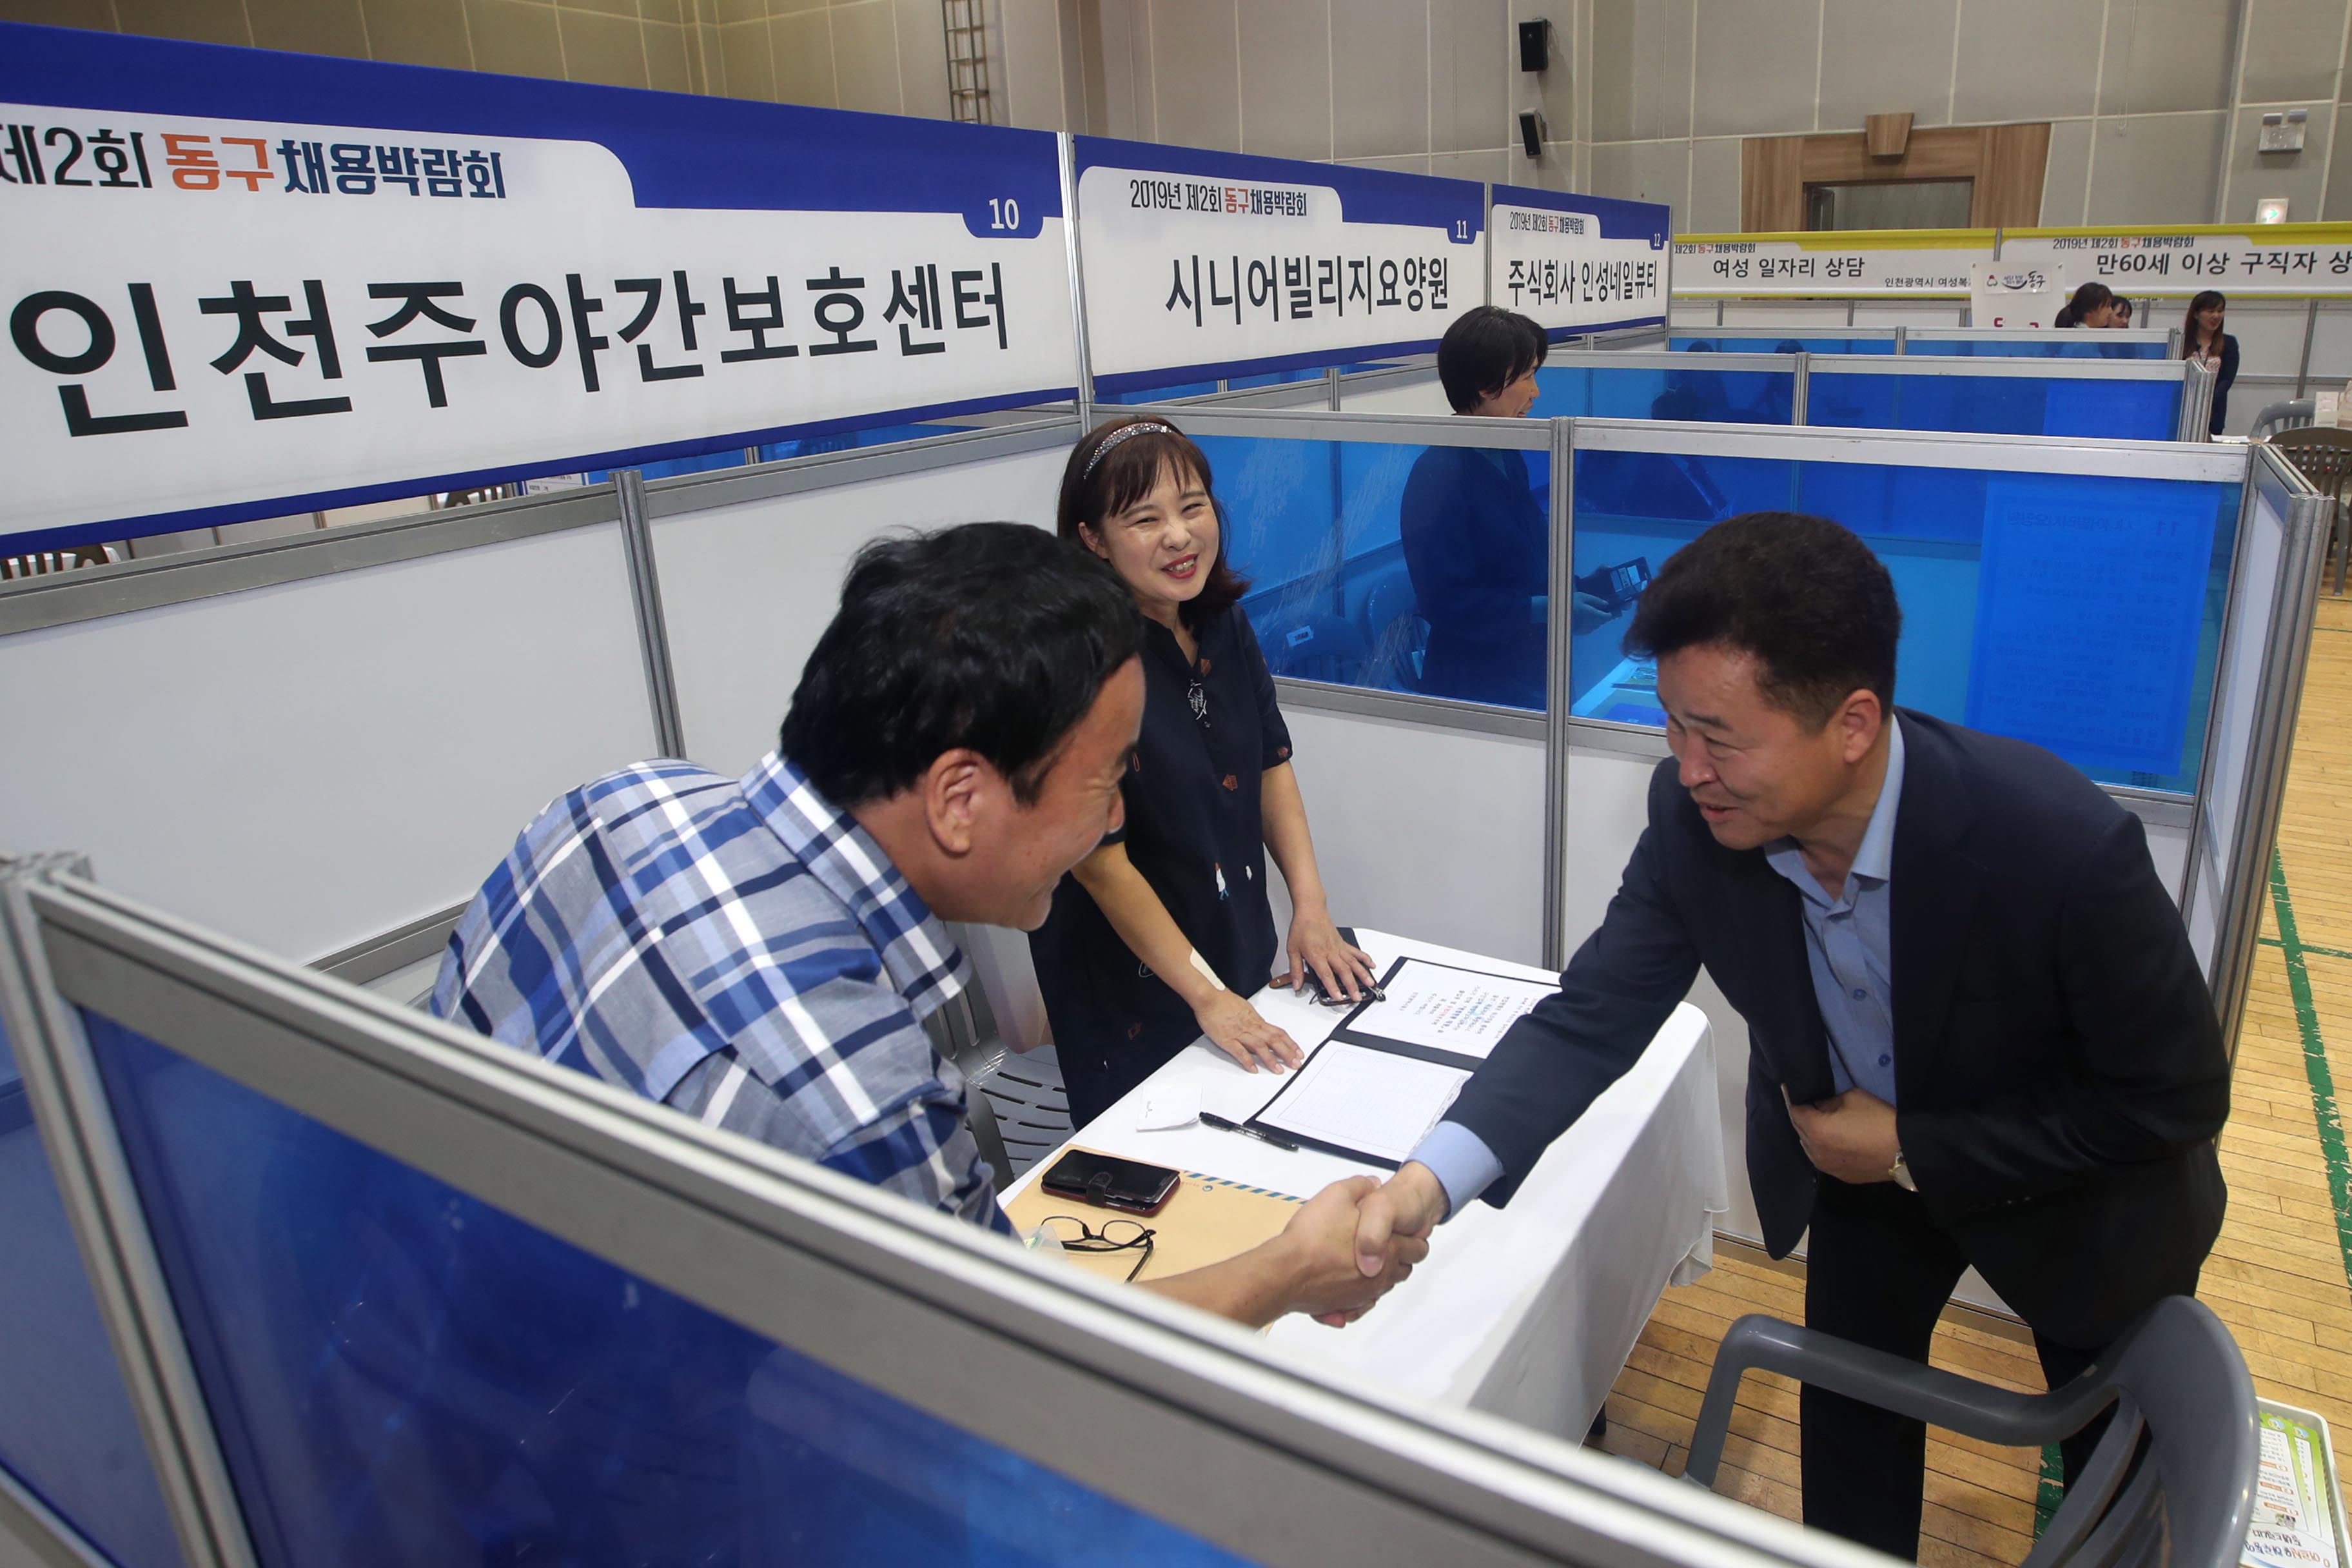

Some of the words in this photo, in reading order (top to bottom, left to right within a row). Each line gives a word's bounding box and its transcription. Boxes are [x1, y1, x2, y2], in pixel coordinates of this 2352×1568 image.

[0, 124, 153, 188] 제2회
[1130, 179, 1181, 210] 2019년
[1185, 183, 1222, 212] 제2회
[988, 198, 1020, 230] 10
[1509, 211, 1531, 230] 2019년
[1532, 213, 1547, 232] 제2회
[1456, 220, 1469, 239] 11
[1653, 233, 1661, 247] 12
[1674, 244, 1696, 253] 제2회
[2053, 237, 2088, 250] 2019년
[2091, 237, 2118, 249] 제2회
[1713, 258, 1749, 278] 여성
[1758, 257, 1815, 278] 일자리
[1825, 257, 1865, 278] 상담
[2097, 253, 2170, 275] 만60세
[2182, 252, 2230, 275] 이상
[2240, 251, 2318, 275] 구직자
[2328, 251, 2352, 274] 상
[1508, 259, 1575, 307] 주식회사
[1582, 260, 1657, 302] 인성네일뷰티
[1885, 277, 1933, 288] 인천광역시
[2028, 270, 2046, 288] 동구
[1165, 255, 1448, 328] 시니어빌리지요양원
[9, 262, 1009, 438] 인천주야간보호센터
